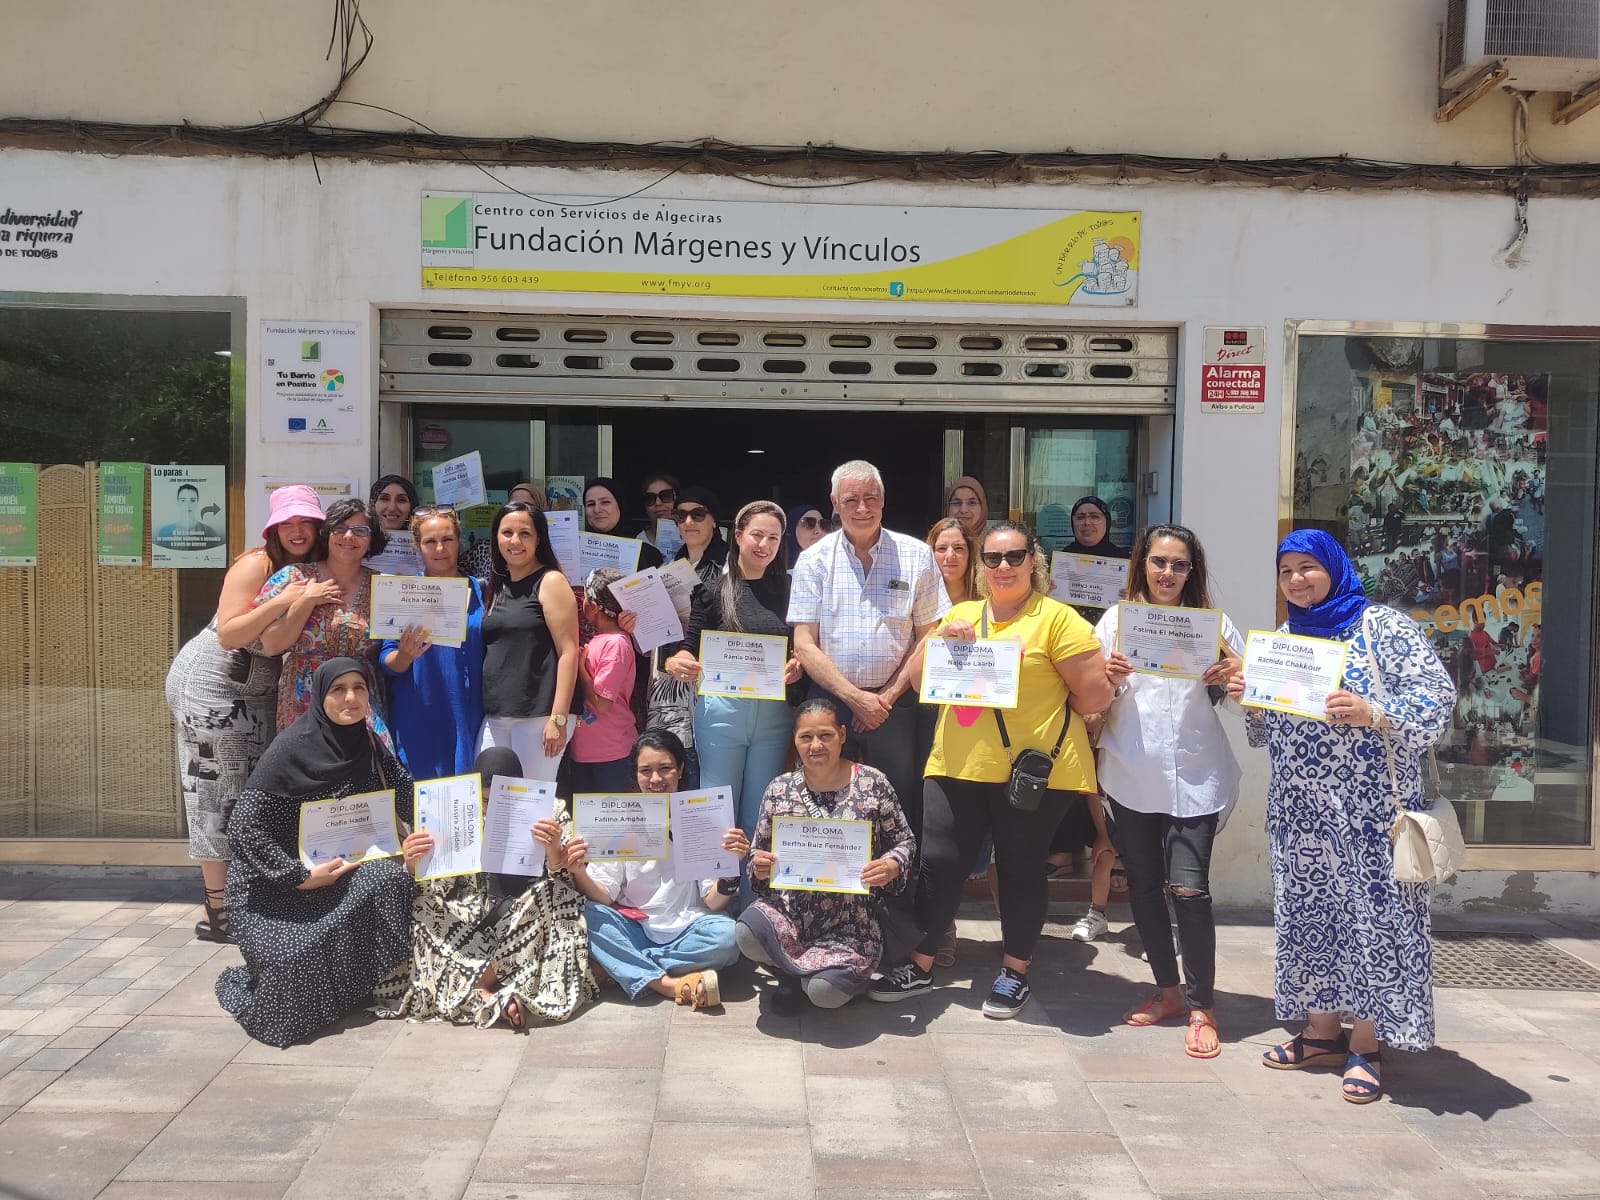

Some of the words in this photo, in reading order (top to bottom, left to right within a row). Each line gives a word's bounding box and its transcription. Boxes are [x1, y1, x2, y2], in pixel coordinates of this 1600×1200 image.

[0, 208, 83, 229] diversidad
[474, 204, 524, 216] Centro
[529, 208, 555, 218] con
[560, 207, 627, 220] Servicios
[632, 210, 650, 221] de
[655, 210, 723, 225] Algeciras
[16, 228, 74, 248] riqueza
[475, 225, 624, 255] Fundación
[634, 231, 773, 263] Márgenes
[781, 241, 797, 266] y
[803, 236, 921, 263] Vínculos
[5, 249, 18, 257] DE
[21, 249, 59, 259] TOD@S
[433, 272, 478, 282] Teléfono
[481, 274, 498, 282] 956
[501, 275, 519, 283] 603
[521, 275, 539, 284] 439
[641, 279, 711, 289] www.fmyv.org
[298, 327, 325, 335] Márgenes
[1216, 345, 1256, 362] Direct
[277, 371, 288, 379] Tu
[290, 371, 315, 379] Barrio
[1206, 366, 1261, 379] Alarma
[1206, 379, 1261, 388] conectada
[1208, 390, 1224, 398] 24H
[154, 468, 162, 477] Lo
[587, 539, 620, 549] DIPLOMA
[401, 583, 442, 591] DIPLOMA
[1070, 591, 1102, 602] DIPLOMA
[1147, 612, 1191, 624] DIPLOMA
[1133, 625, 1157, 635] Fatima
[1168, 630, 1203, 639] Mahjoubi
[727, 640, 763, 649] DIPLOMA
[953, 645, 994, 654] DIPLOMA
[1272, 641, 1314, 655] DIPLOMA
[1285, 660, 1322, 672] Chakkour
[329, 801, 369, 814] DIPLOMA
[601, 801, 642, 809] DIPLOMA
[801, 787, 822, 818] BIMBA
[466, 804, 476, 847] DIPLOMA
[802, 826, 844, 835] DIPLOMA
[824, 842, 862, 851] Fernández
